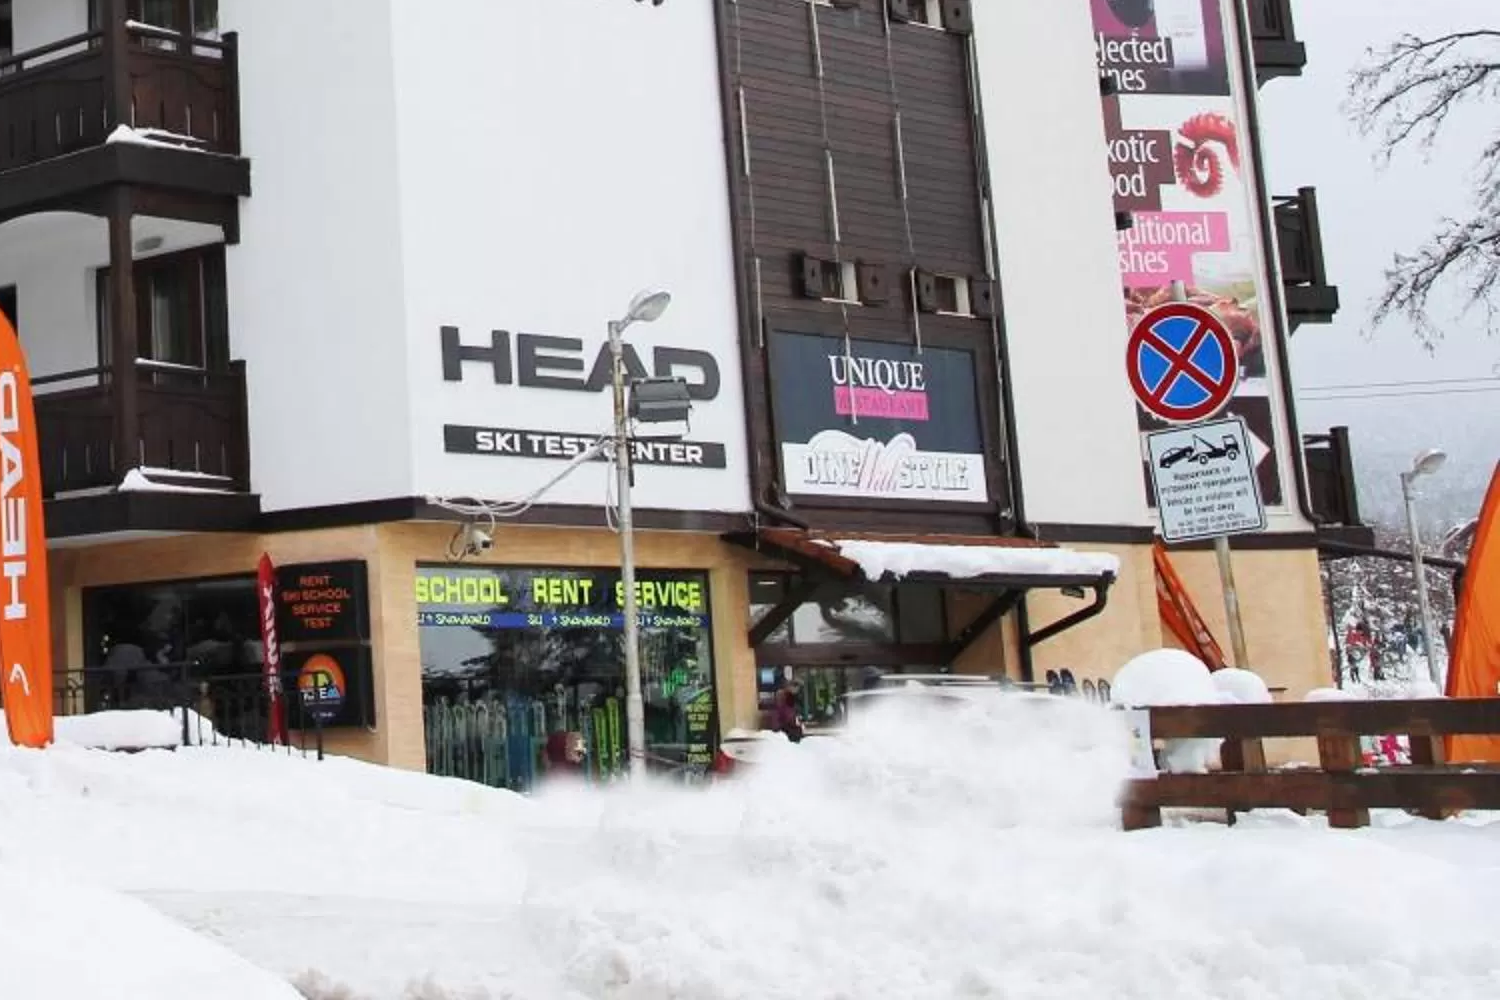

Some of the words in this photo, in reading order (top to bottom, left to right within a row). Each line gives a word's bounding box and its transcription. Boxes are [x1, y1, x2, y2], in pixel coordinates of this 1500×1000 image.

[1098, 31, 1168, 63] lected
[1103, 132, 1160, 163] xotic
[1118, 243, 1169, 273] shes
[440, 325, 721, 401] HEAD
[828, 354, 925, 395] UNIQUE
[475, 431, 521, 453] SKI
[527, 434, 598, 457] TEST
[415, 575, 509, 604] SCHOOL
[532, 577, 594, 606] RENT
